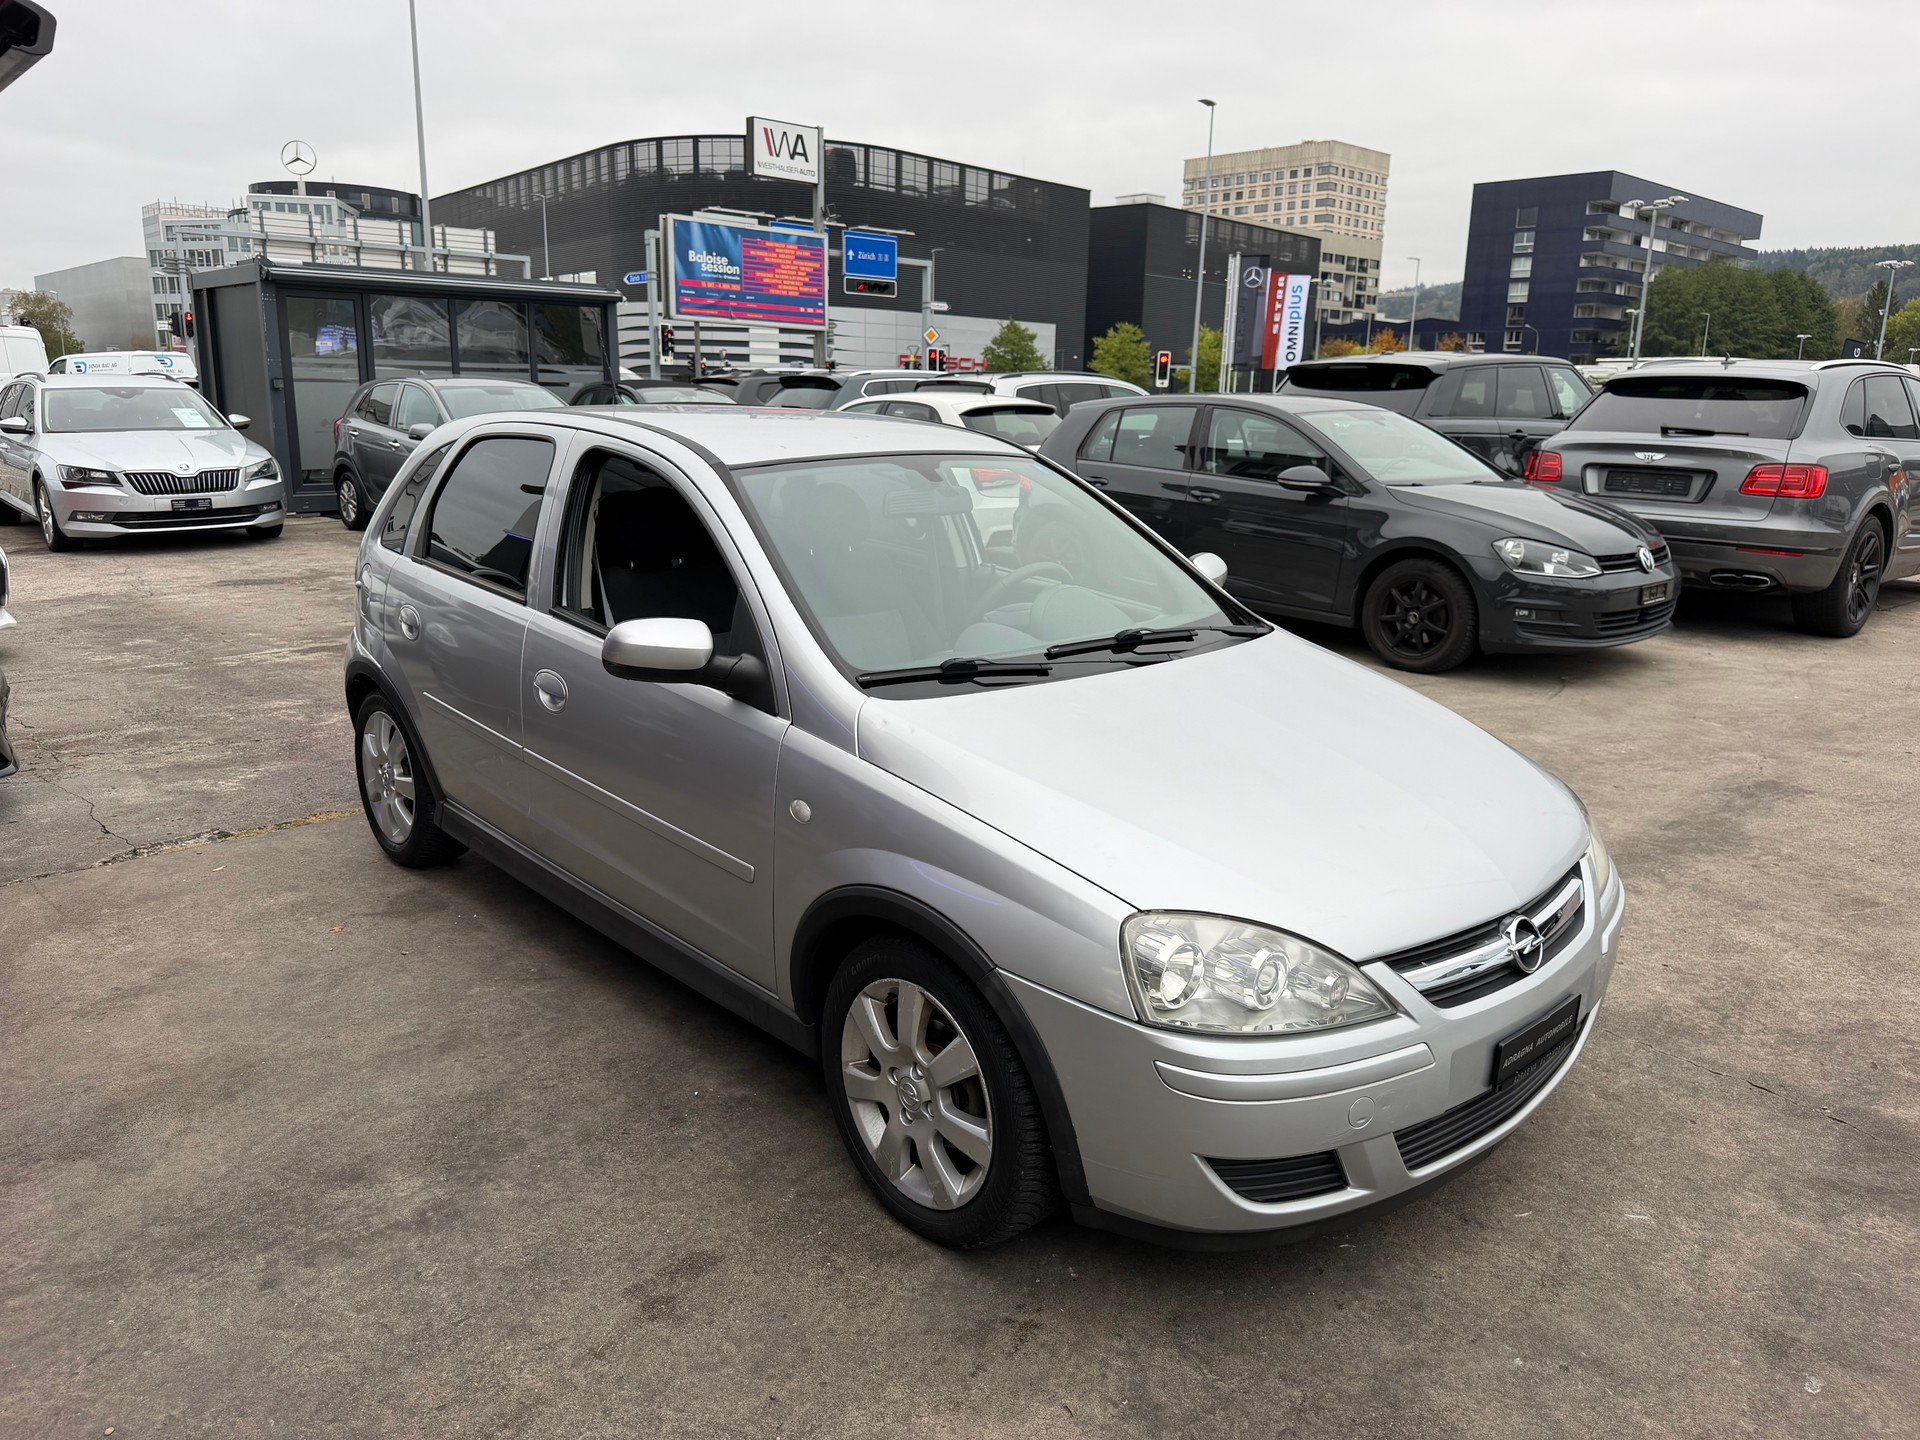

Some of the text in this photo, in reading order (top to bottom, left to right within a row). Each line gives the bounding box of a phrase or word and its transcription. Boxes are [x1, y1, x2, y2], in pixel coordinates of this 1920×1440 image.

[688, 250, 728, 265] Baloise
[701, 262, 740, 275] session
[857, 250, 877, 261] Zürich
[1272, 276, 1286, 335] SETRA
[1285, 284, 1303, 362] OMNIplus
[1502, 1042, 1534, 1069] ADRAGNA
[1536, 1014, 1574, 1047] AUTOMOBILE
